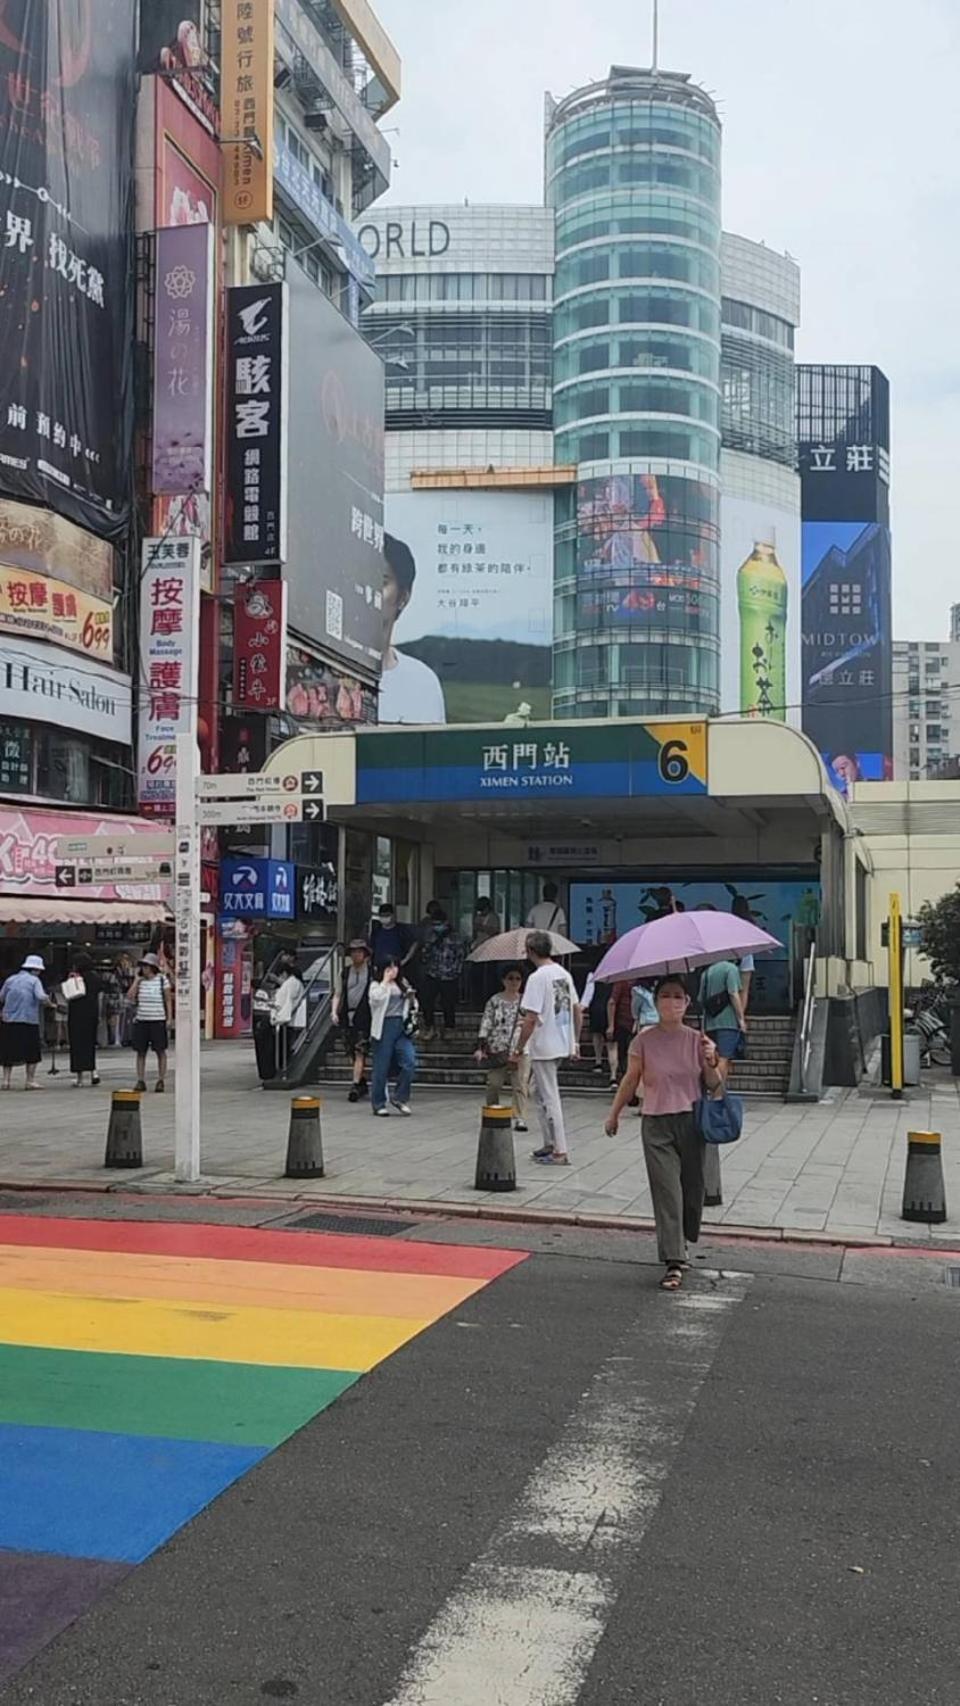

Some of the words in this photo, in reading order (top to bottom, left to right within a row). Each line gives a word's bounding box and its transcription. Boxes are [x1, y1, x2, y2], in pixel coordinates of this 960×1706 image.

[236, 2, 254, 93] 陸號行旅
[358, 221, 450, 259] ORLD
[235, 355, 271, 439] 駭客
[809, 444, 873, 472] 立莊
[7, 580, 48, 608] 按摩
[151, 577, 183, 637] 按摩
[5, 662, 67, 700] Hair
[68, 681, 116, 716] Salon
[149, 661, 182, 722] 護膚
[482, 741, 571, 771] 西門站
[659, 739, 689, 784] 6
[480, 777, 519, 788] XIMEN
[521, 775, 573, 786] STATION
